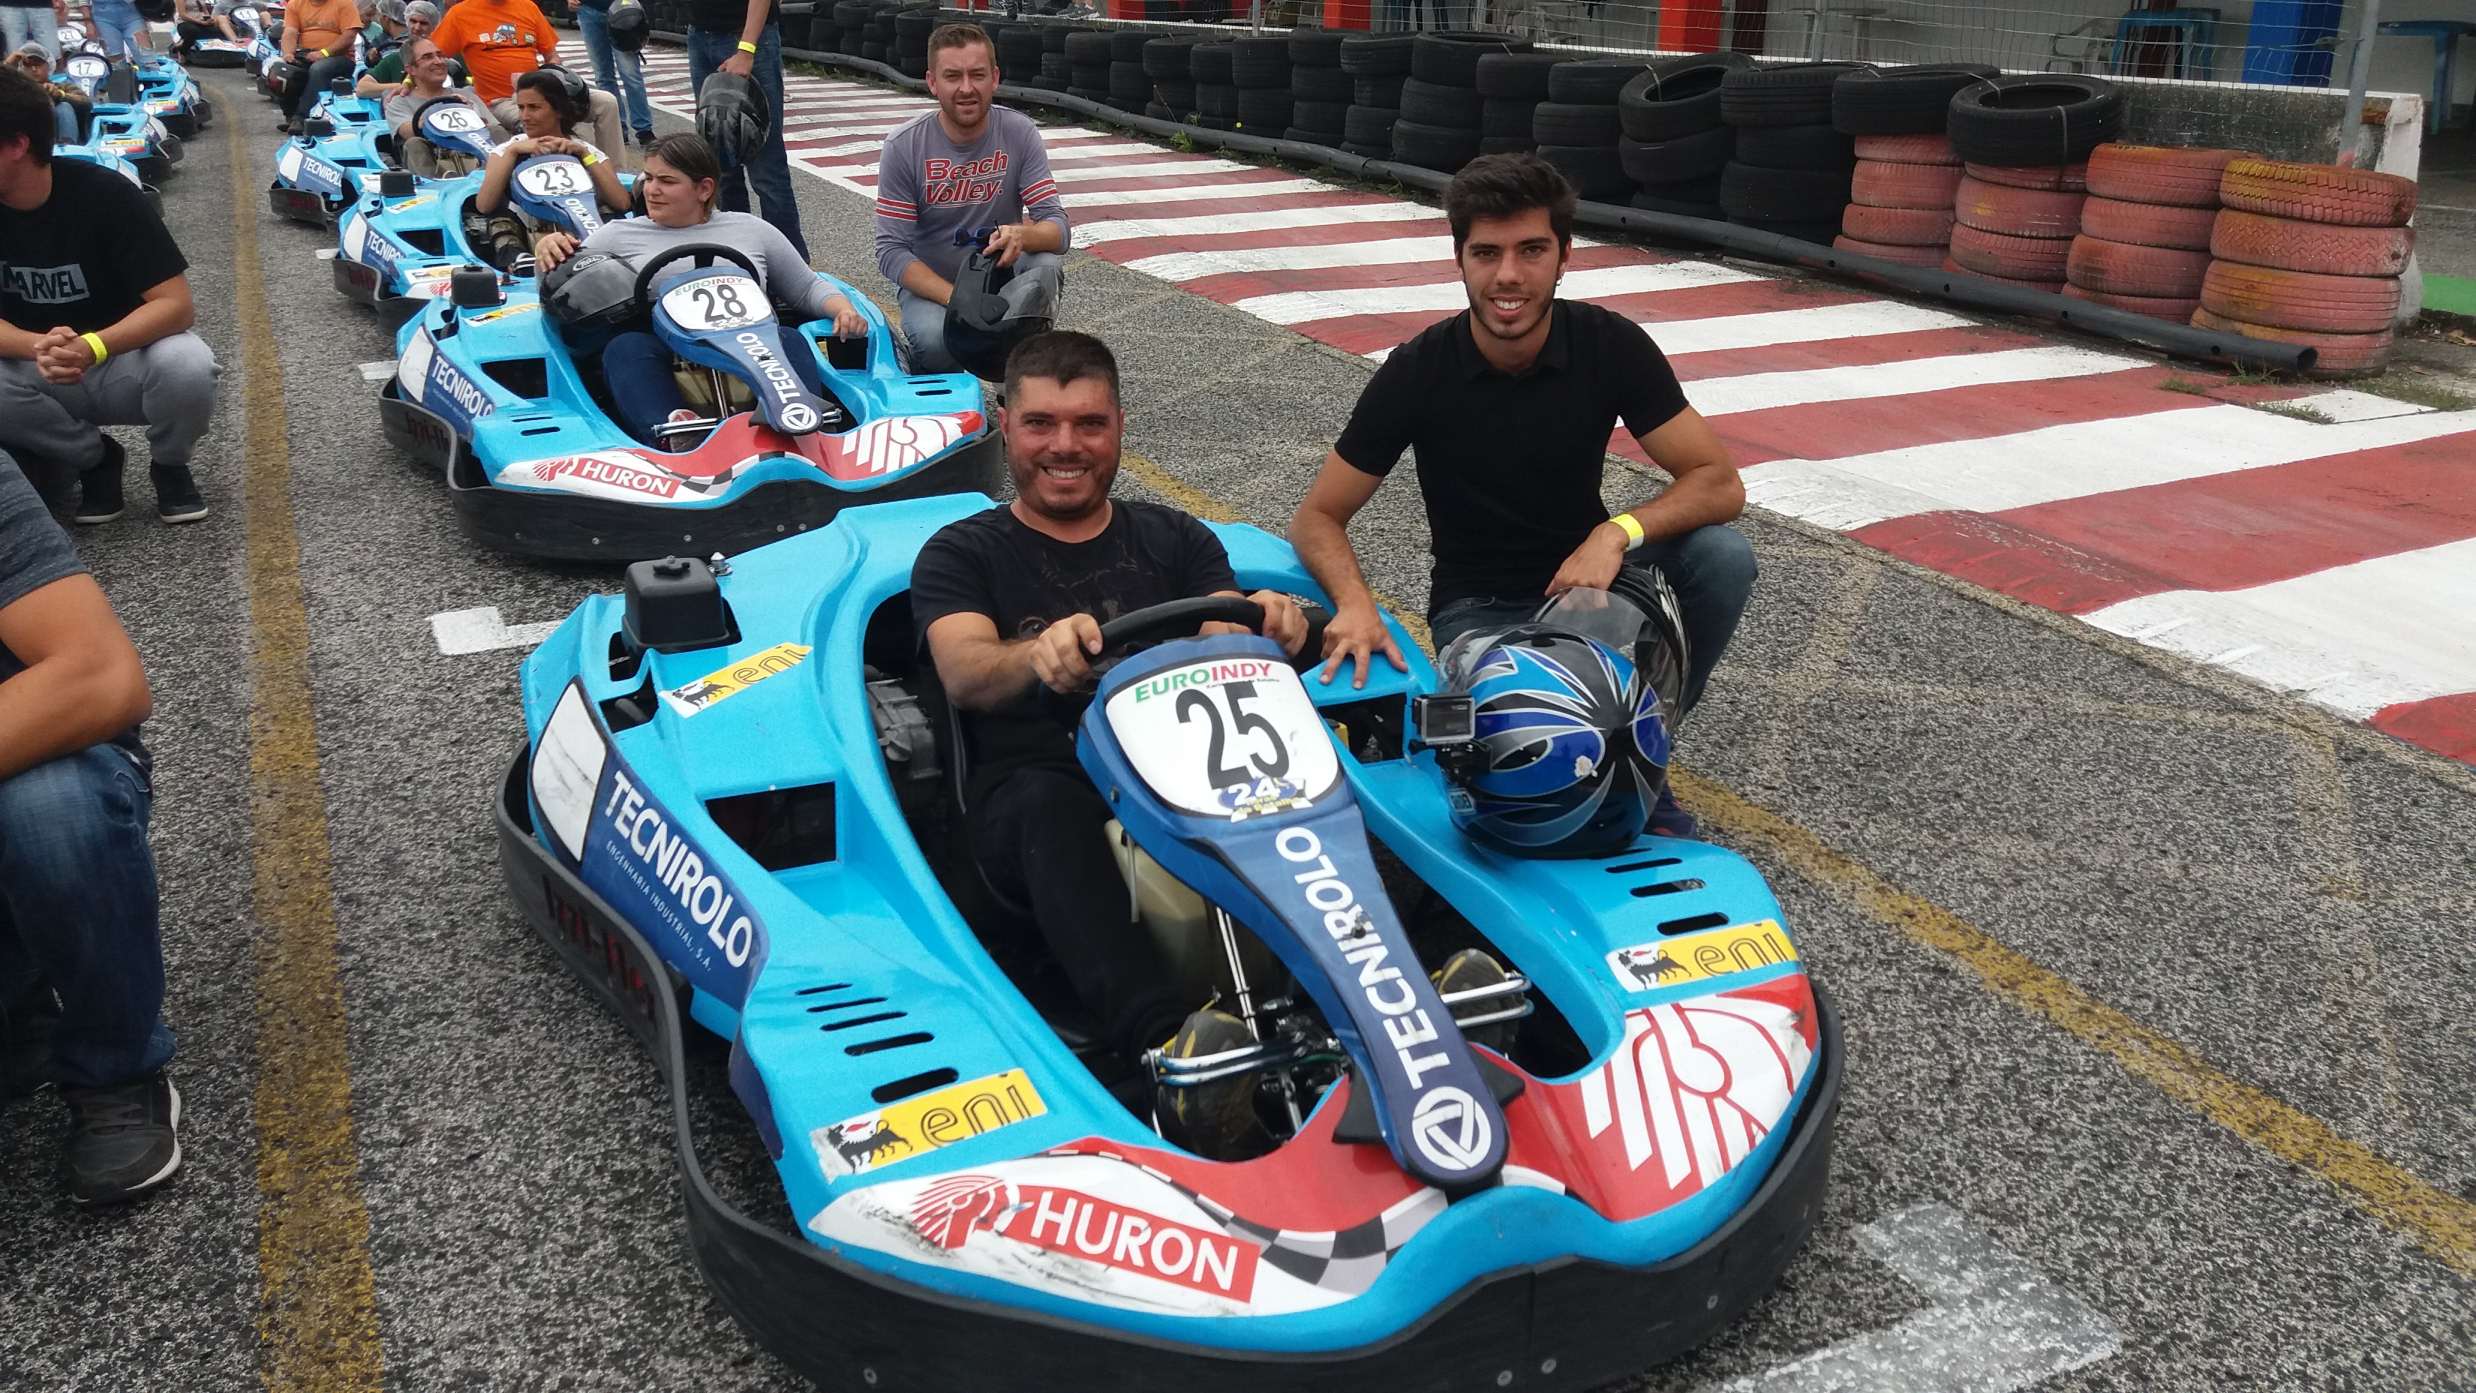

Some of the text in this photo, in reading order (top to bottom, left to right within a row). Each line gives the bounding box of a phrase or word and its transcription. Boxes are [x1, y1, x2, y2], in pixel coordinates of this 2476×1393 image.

[76, 62, 91, 76] 17
[441, 112, 468, 129] 26
[303, 157, 342, 187] TECNIROL
[535, 166, 574, 191] 23
[925, 150, 1008, 181] Beach
[367, 230, 405, 262] TECNIRO
[2, 263, 86, 300] MARVEL
[674, 277, 743, 296] EUROINDY
[692, 284, 747, 323] 28
[581, 460, 672, 495] HURON
[732, 645, 807, 685] eni
[1135, 663, 1271, 703] EUROINDY
[1175, 681, 1290, 790] 25
[604, 770, 753, 968] TECNIROLO
[606, 840, 650, 896] ENGENHARIA
[1275, 827, 1450, 1090] TECNIROLO
[1694, 923, 1789, 977] eni
[919, 1073, 1031, 1148] eni
[1029, 1191, 1239, 1291] HURON
